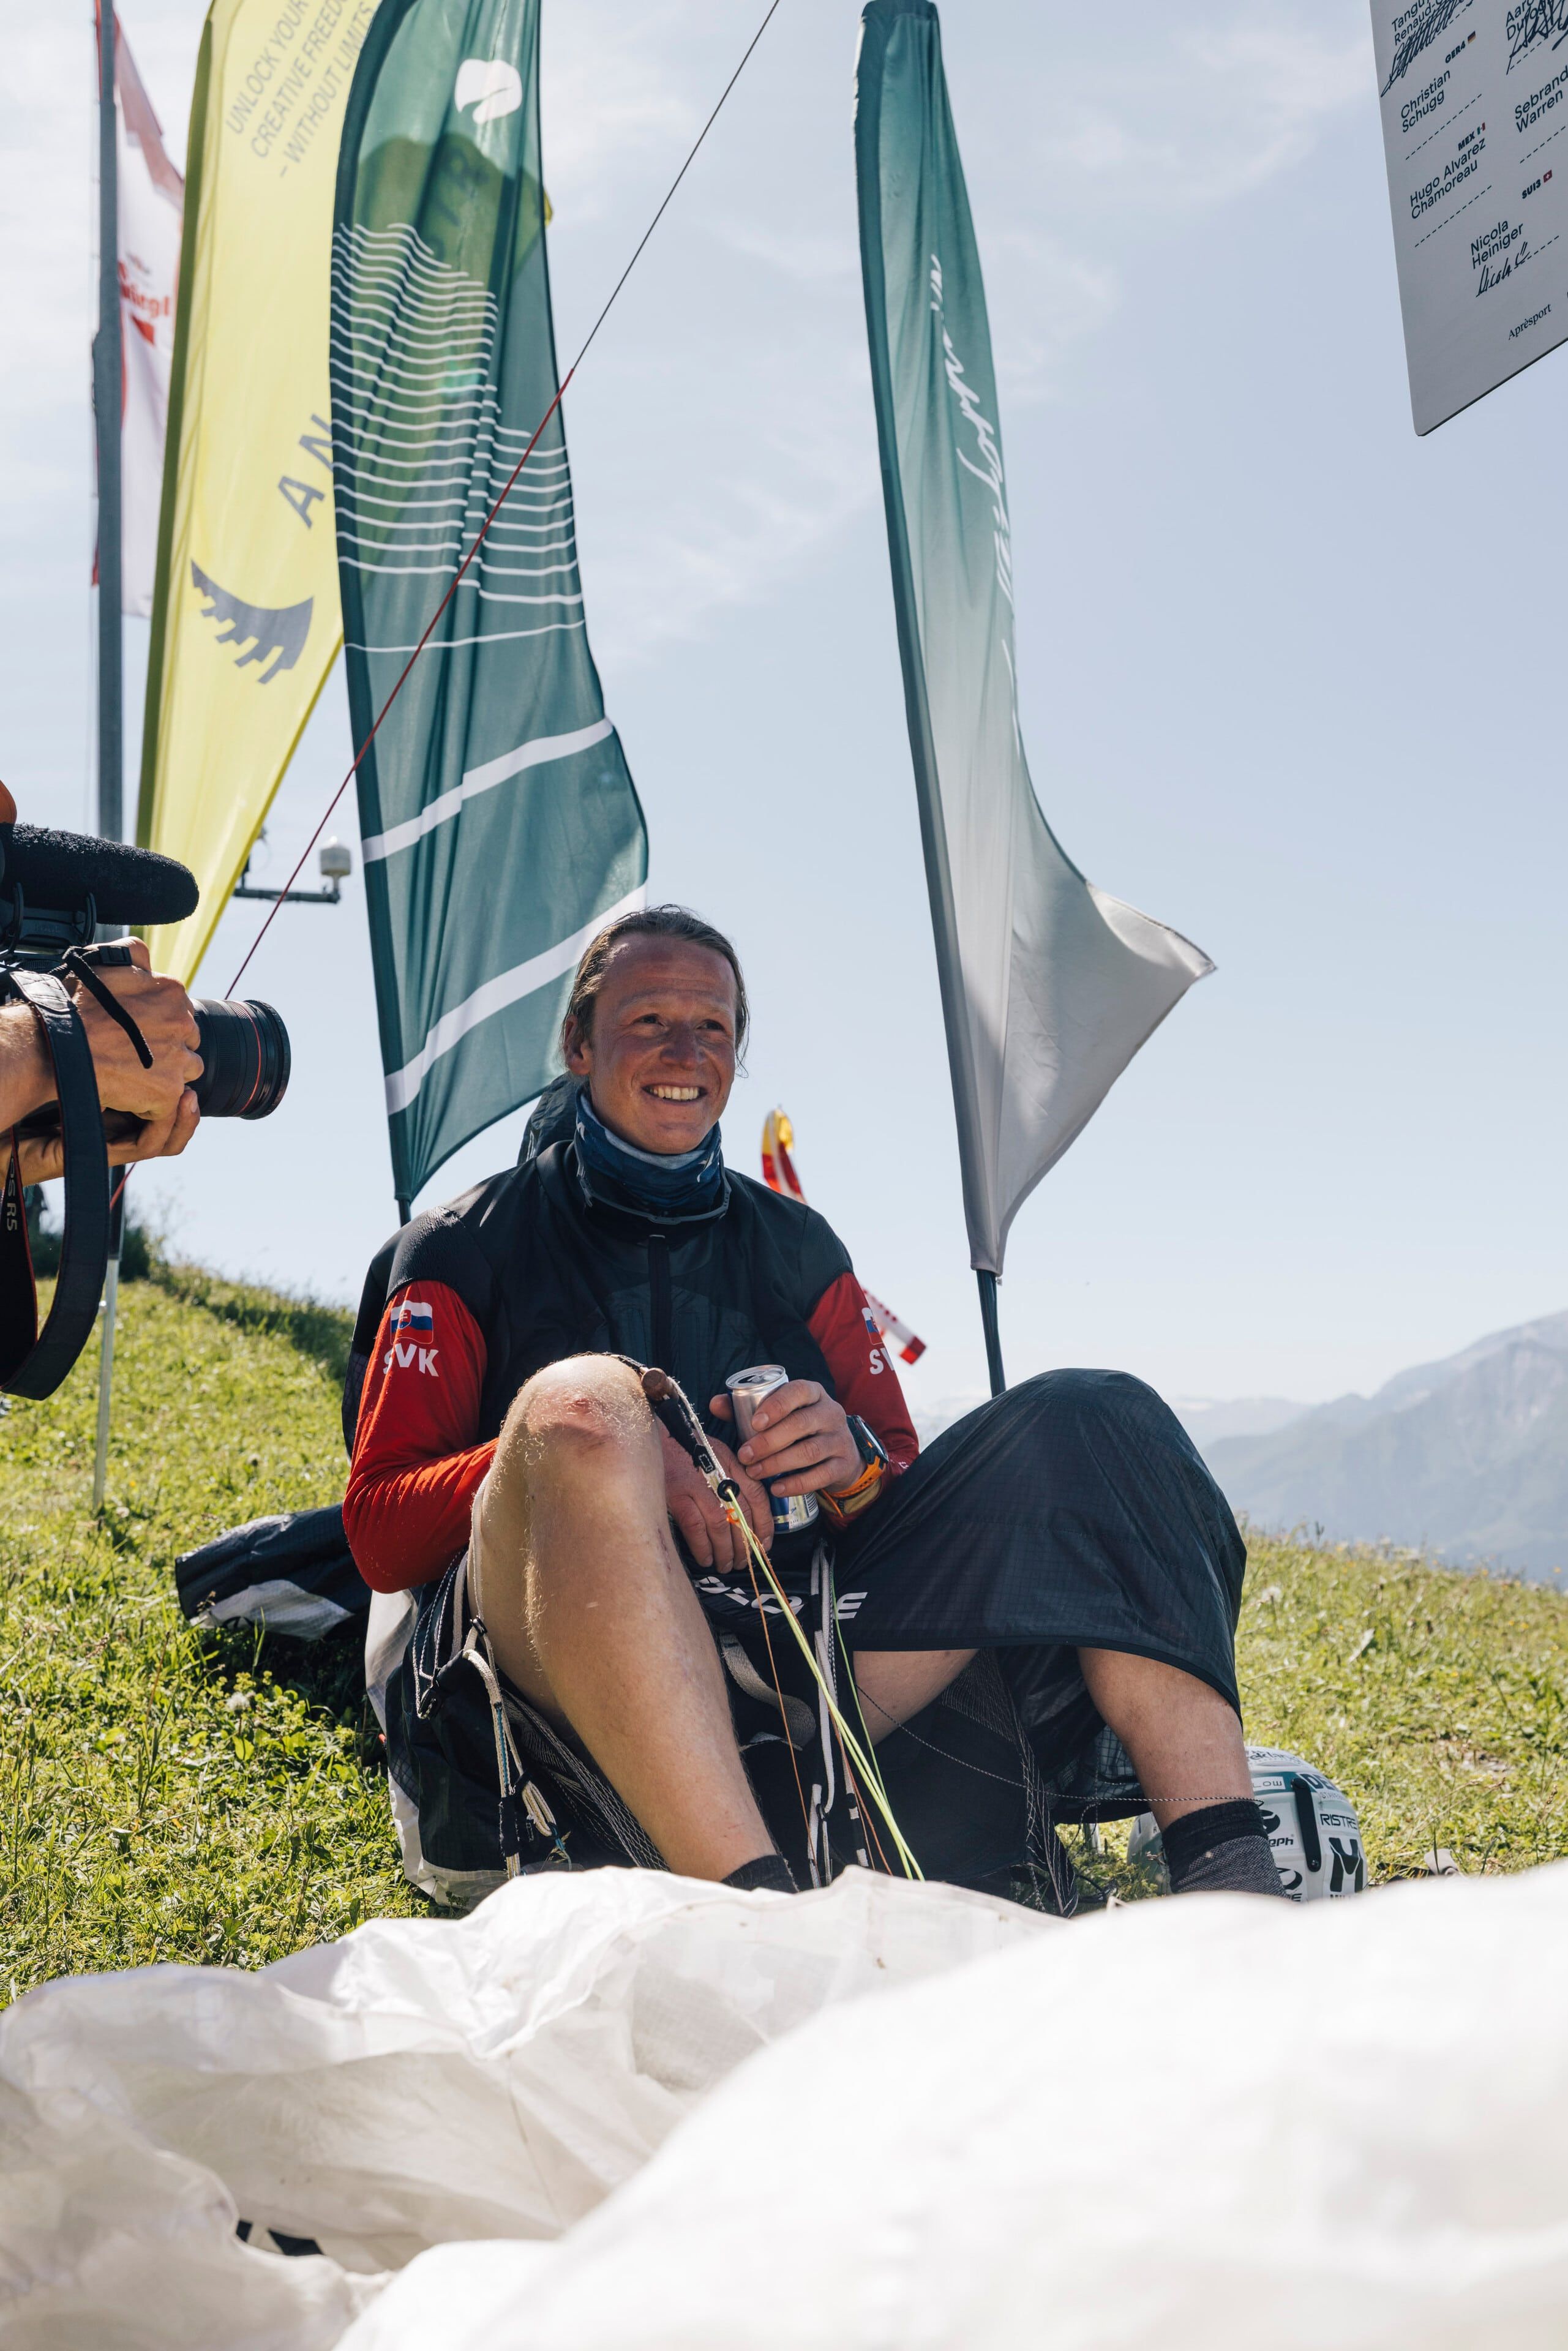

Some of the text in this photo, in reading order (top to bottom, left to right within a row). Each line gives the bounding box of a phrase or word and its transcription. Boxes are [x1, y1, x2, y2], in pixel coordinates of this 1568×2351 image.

[1391, 0, 1430, 32] Tangu
[226, 47, 280, 135] UNLOCK
[283, 66, 342, 163] WITHOUT
[334, 1, 373, 72] LIMITS
[1401, 70, 1450, 119] Christian
[251, 57, 312, 158] CREATIVE
[1403, 90, 1444, 133] Schugg
[1516, 90, 1563, 133] Warren
[1458, 131, 1475, 151] MEX
[1410, 138, 1486, 207] Hugo Alvarez
[1411, 160, 1477, 219] Chamoreau
[1471, 220, 1509, 255] Nicola
[1472, 223, 1523, 269] Heiniger
[1509, 304, 1551, 340] Aprèsport
[7, 1202, 17, 1231] R5
[383, 1343, 439, 1377] SVK
